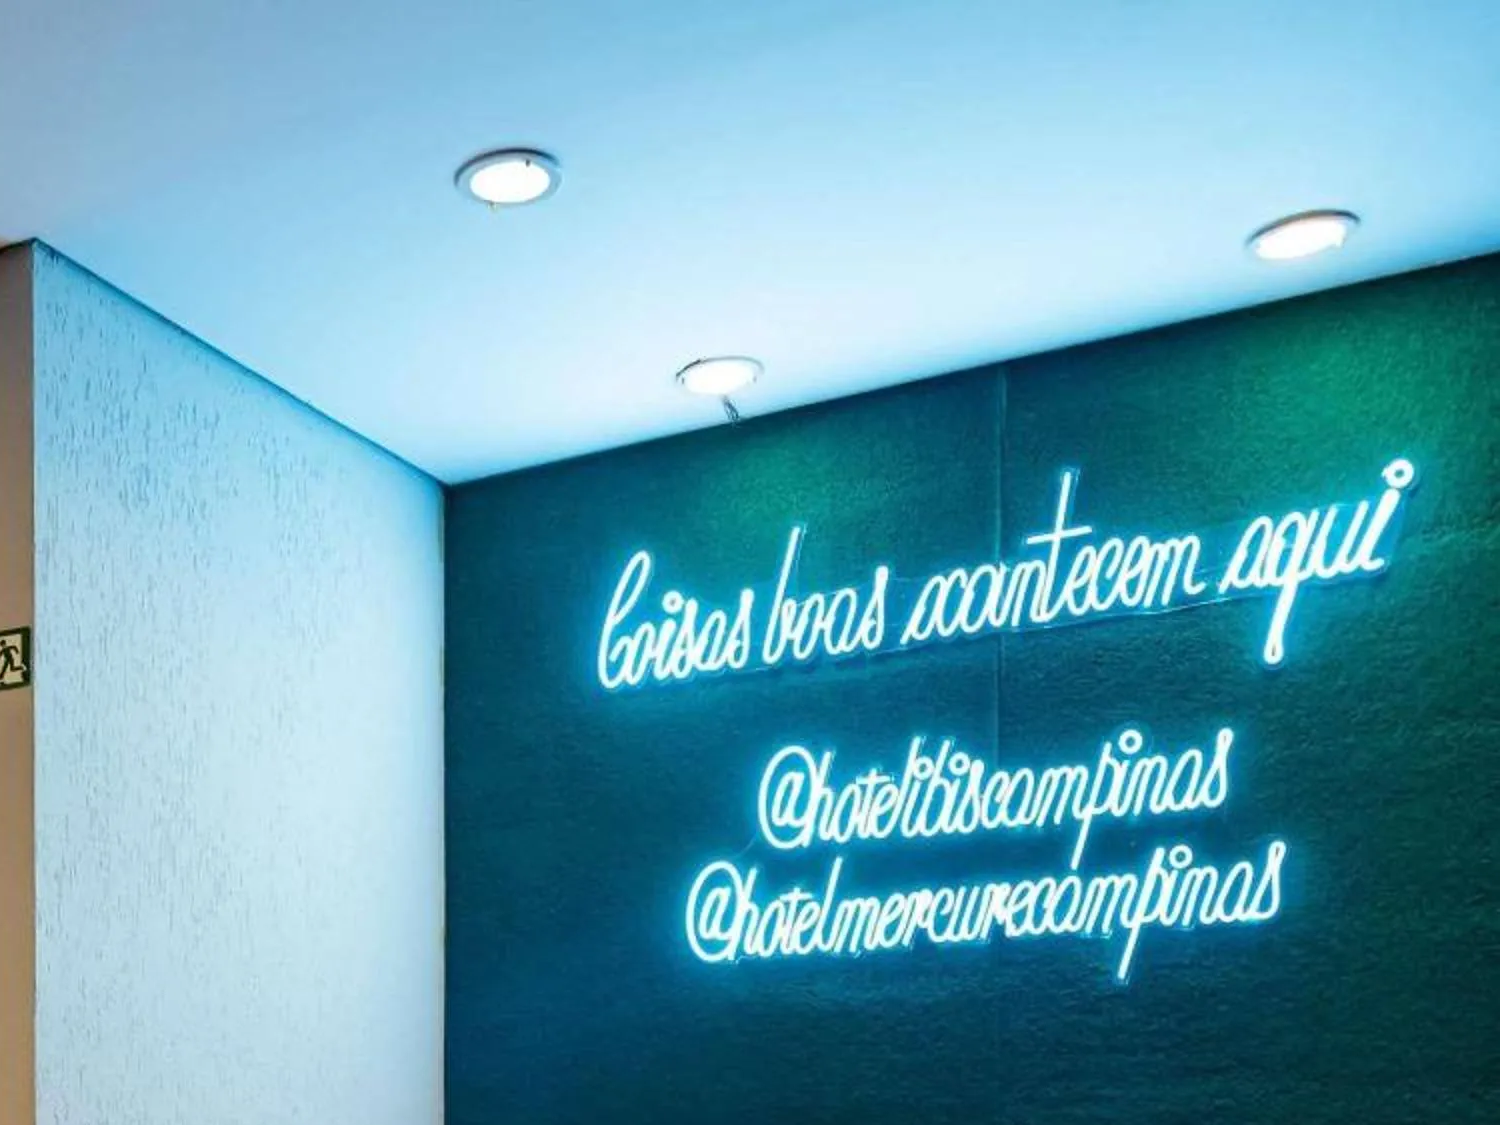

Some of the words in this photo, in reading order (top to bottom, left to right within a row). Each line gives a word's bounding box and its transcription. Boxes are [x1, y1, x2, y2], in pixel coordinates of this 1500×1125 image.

[762, 525, 890, 665] boas
[900, 470, 1206, 645] acontecem
[1219, 457, 1416, 665] aqui
[757, 728, 1234, 870] @hotelibiscampinas
[685, 840, 1286, 982] @hotelmercurecampinas
